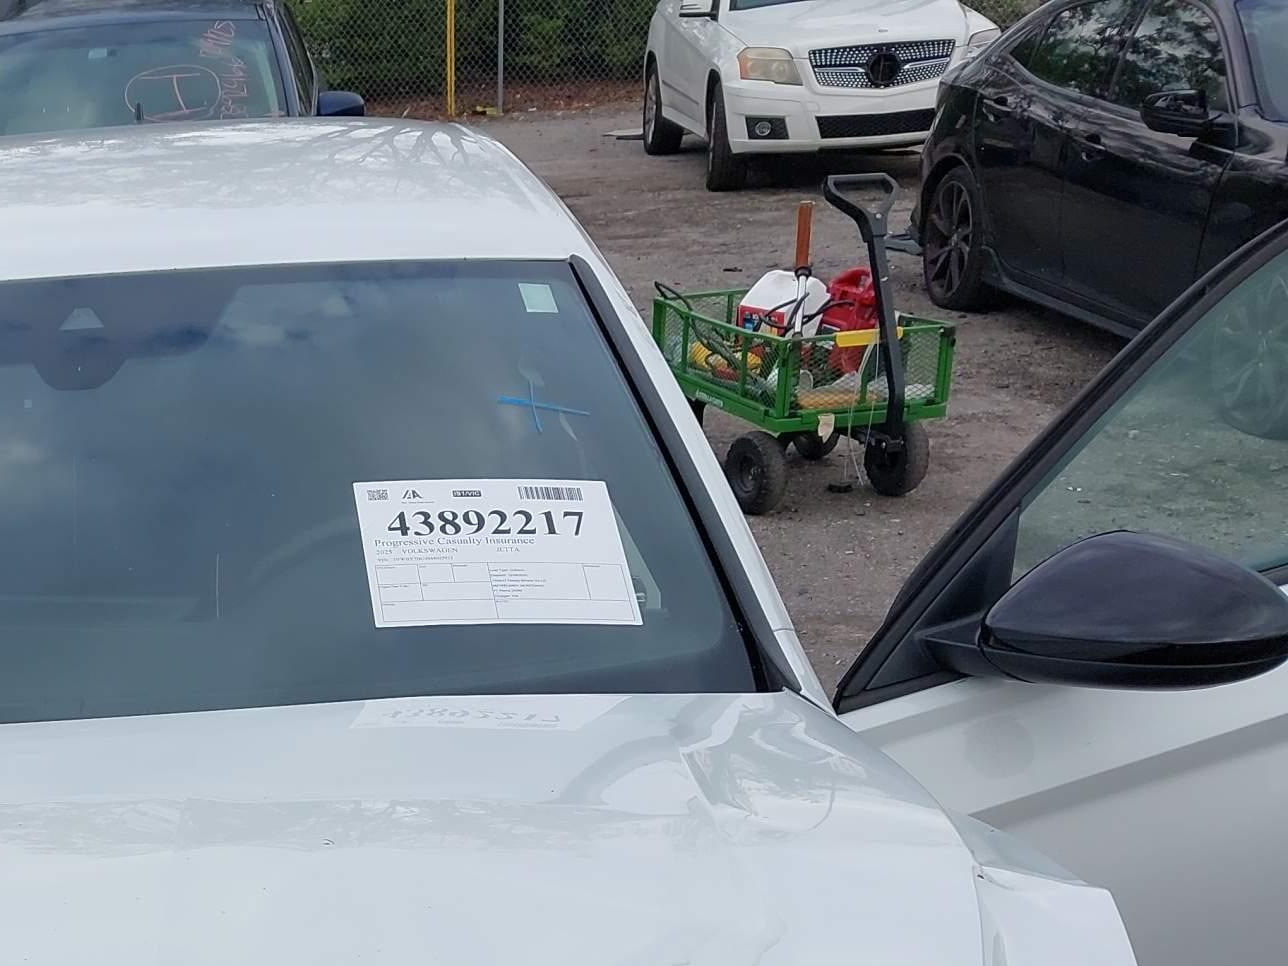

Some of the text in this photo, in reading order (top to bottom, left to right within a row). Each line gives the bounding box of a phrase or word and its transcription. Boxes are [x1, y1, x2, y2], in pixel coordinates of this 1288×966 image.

[387, 509, 584, 537] 43892217
[374, 536, 536, 547] Progressive Casualty Insurance
[401, 547, 459, 555] VOLKSWAGEN
[496, 546, 520, 554] JETTA
